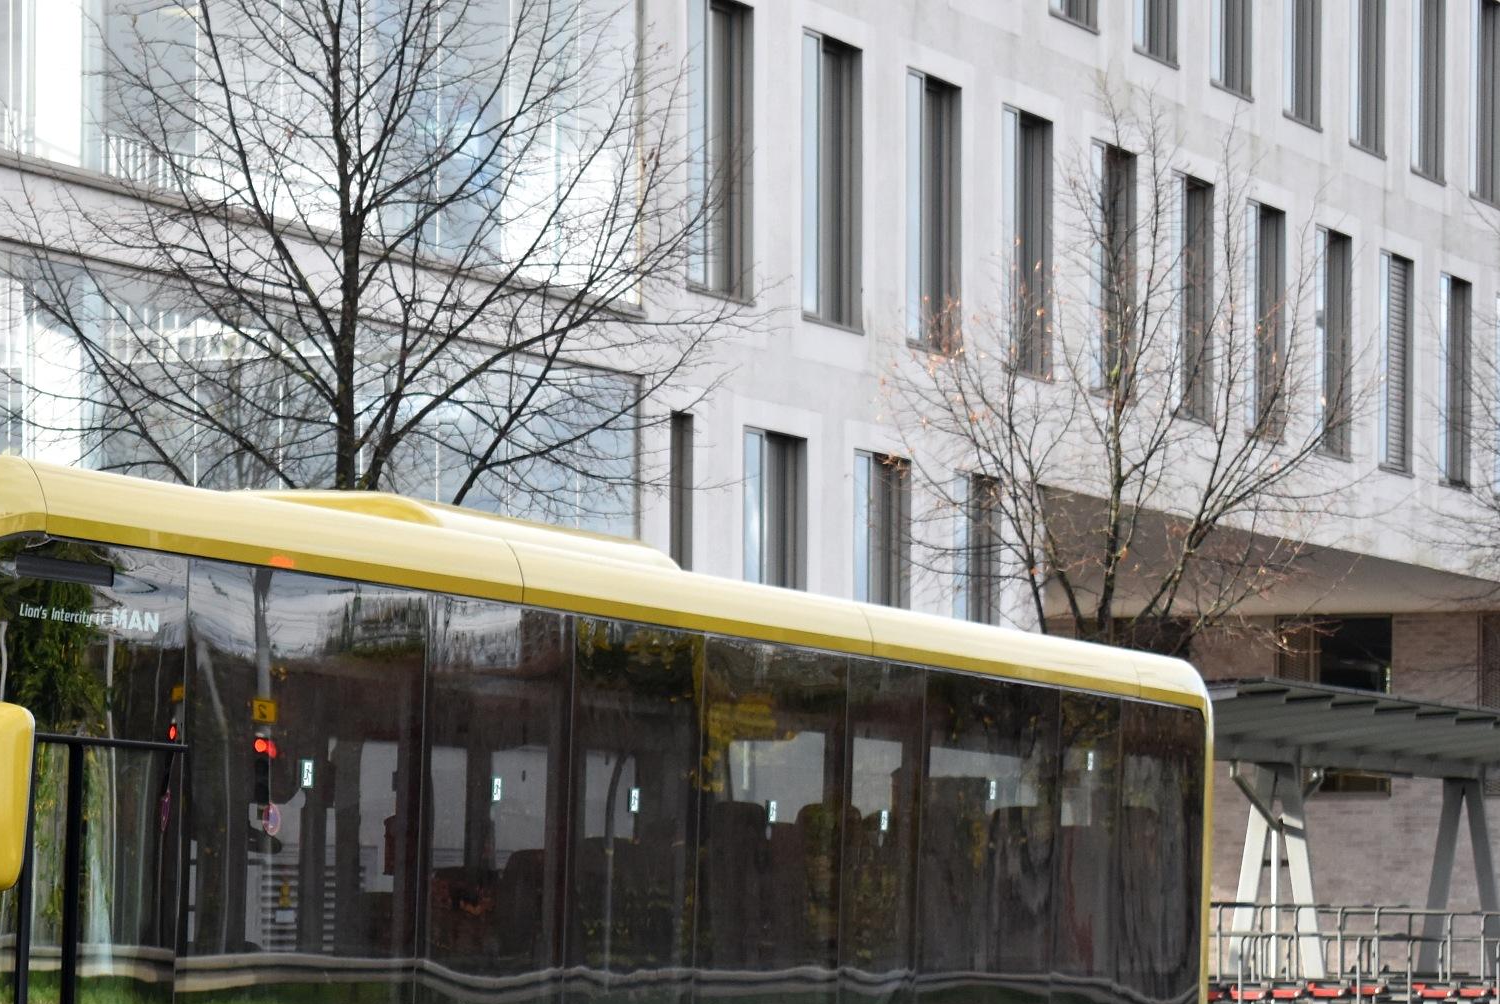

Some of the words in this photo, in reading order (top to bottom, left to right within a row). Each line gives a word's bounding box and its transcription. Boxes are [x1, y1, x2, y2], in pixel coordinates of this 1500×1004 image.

[19, 602, 47, 619] Lion's
[51, 607, 92, 627] Intercity
[112, 608, 160, 633] MAN
